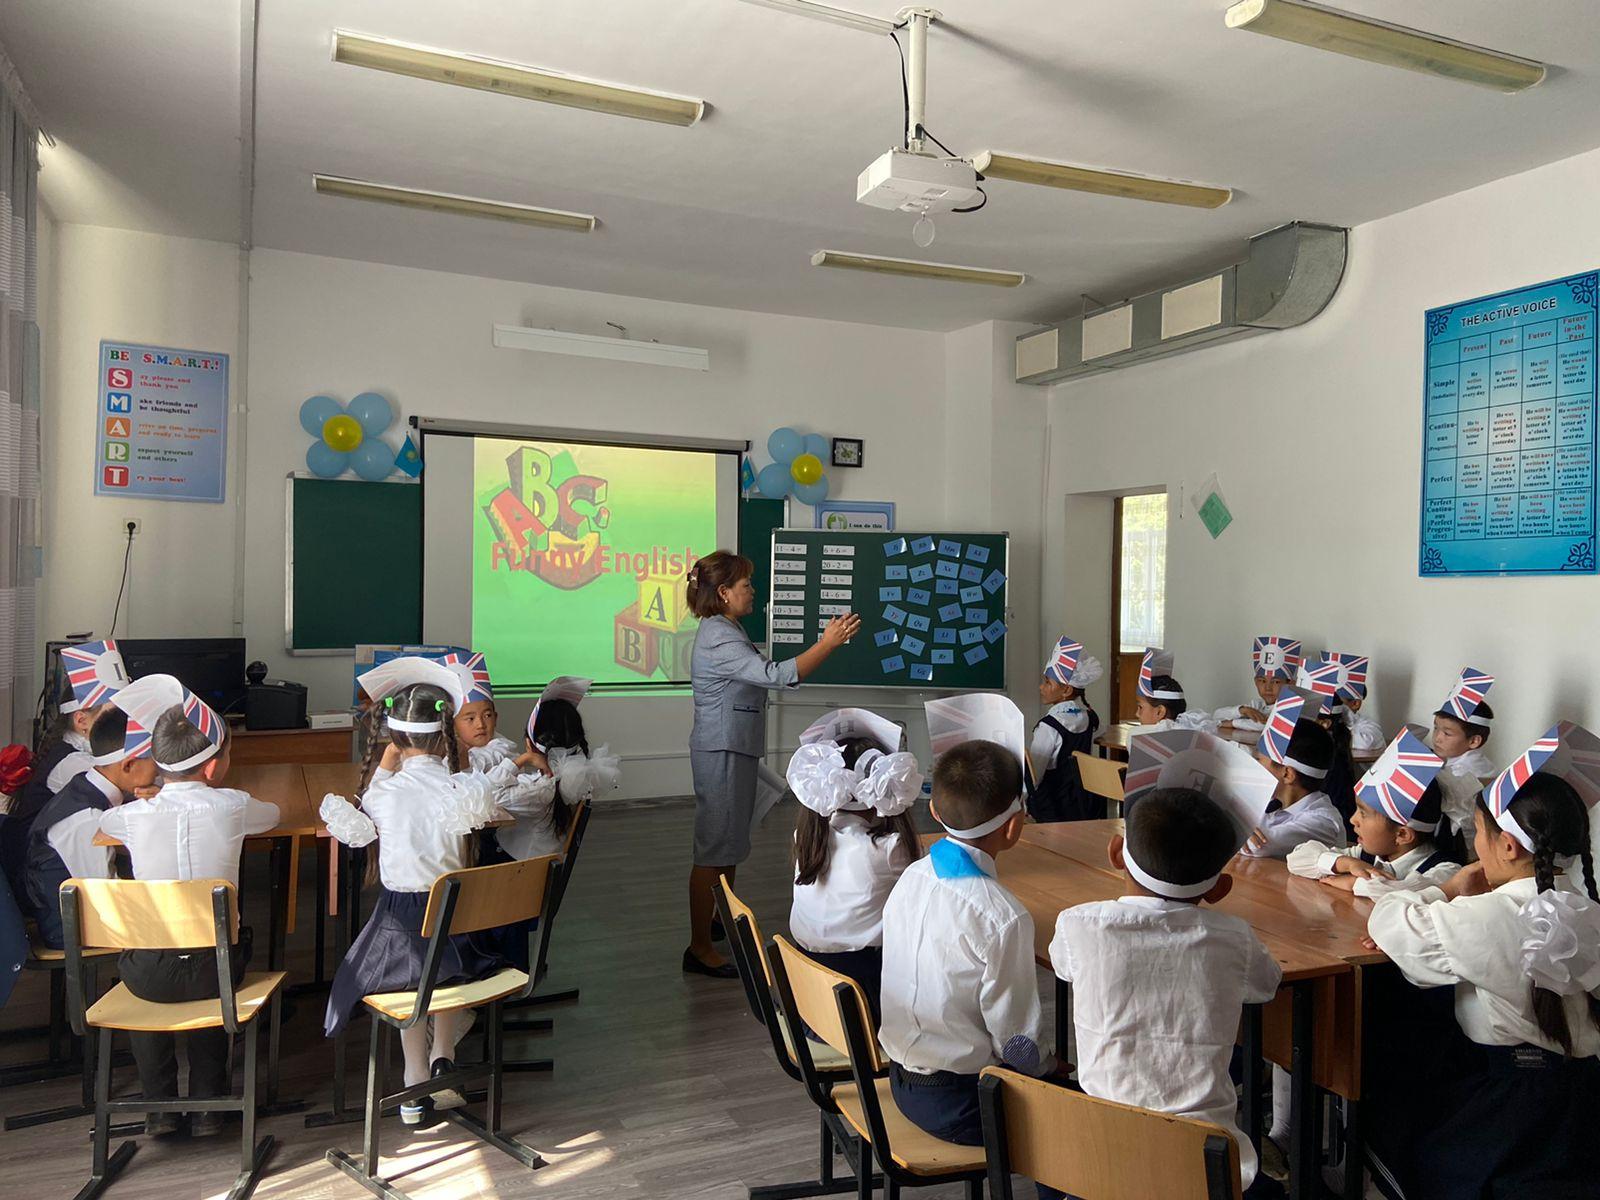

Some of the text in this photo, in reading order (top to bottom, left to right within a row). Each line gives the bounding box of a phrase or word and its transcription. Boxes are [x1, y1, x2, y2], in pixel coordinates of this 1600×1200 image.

[1461, 298, 1557, 327] THE ACTIVE VOICE
[1563, 315, 1588, 325] Future
[1499, 338, 1513, 346] Past
[1528, 330, 1552, 340] Future
[110, 350, 219, 370] BE S.M.A.R.T.!
[112, 369, 129, 388] S
[1433, 379, 1455, 388] Simple
[110, 395, 128, 411] M
[151, 406, 191, 415] thoughtful
[156, 399, 181, 407] friends
[109, 420, 127, 436] A
[108, 443, 126, 460] R
[109, 468, 125, 484] T
[1431, 475, 1453, 483] Perfect
[644, 587, 668, 622] A
[621, 628, 641, 663] B
[1264, 652, 1275, 665] E
